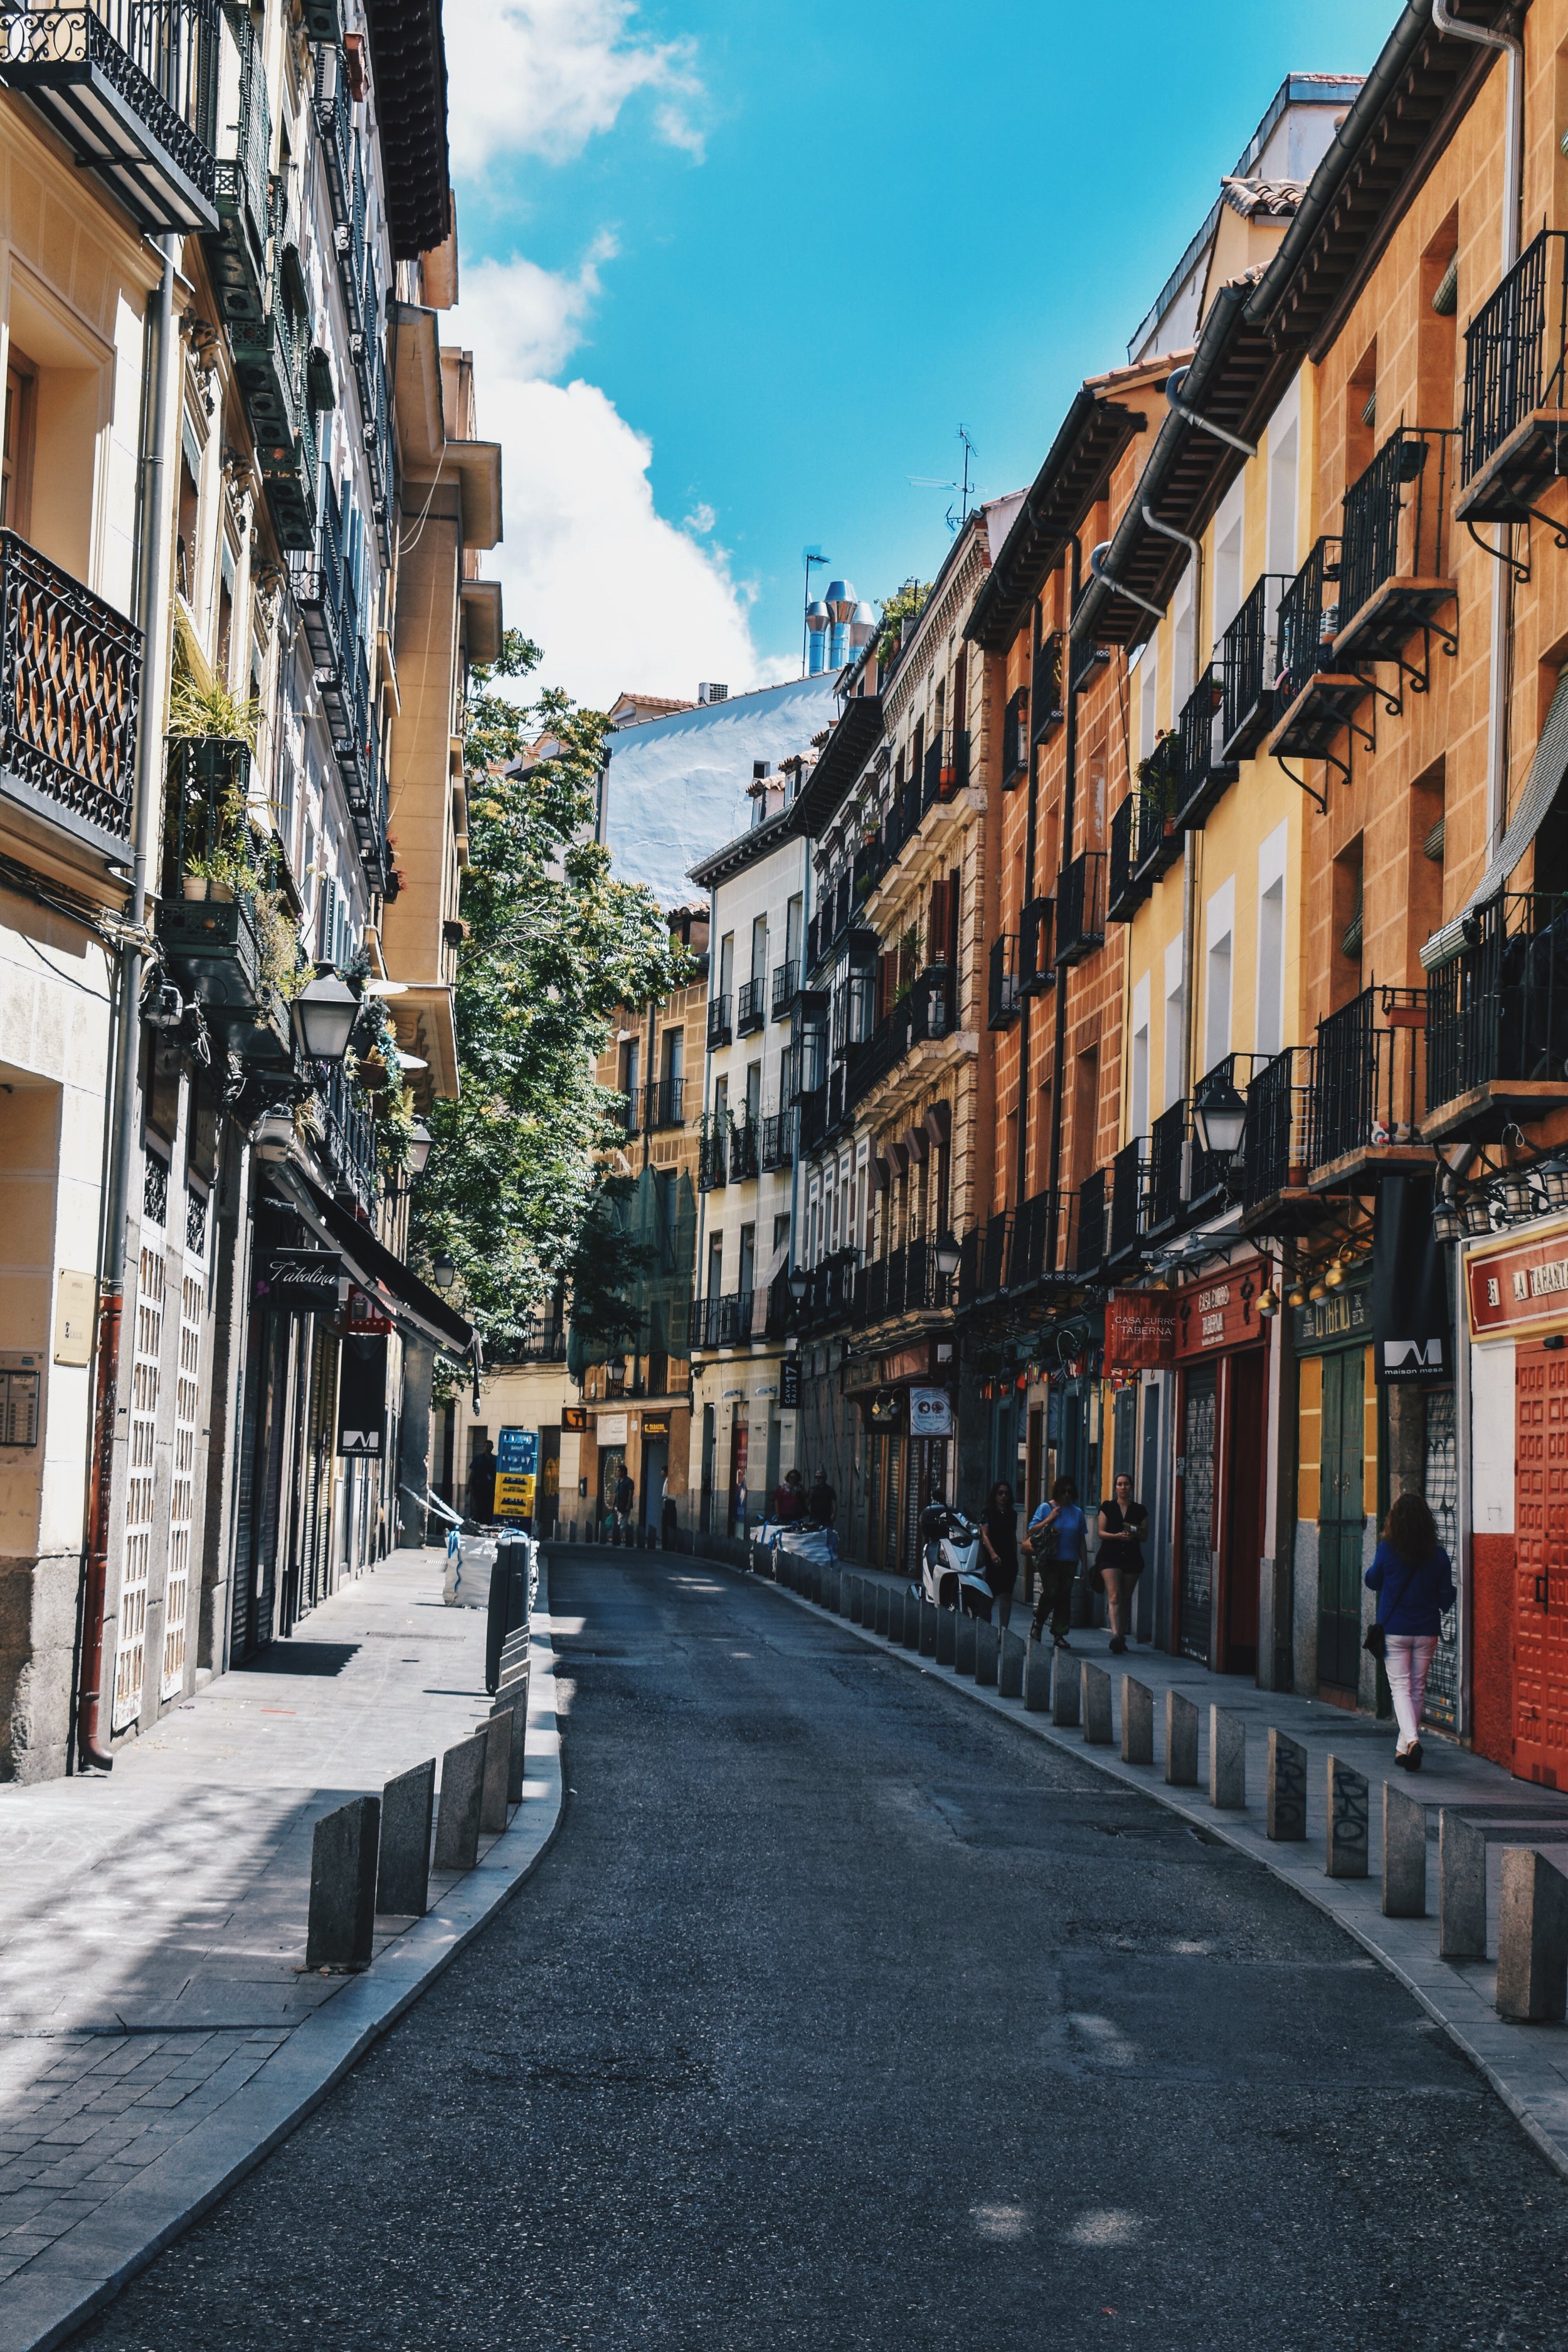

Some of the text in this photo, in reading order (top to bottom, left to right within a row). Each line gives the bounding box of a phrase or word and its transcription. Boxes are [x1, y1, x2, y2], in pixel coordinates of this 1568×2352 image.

[1199, 1285, 1230, 1313] CASA CURRO
[1121, 1326, 1172, 1335] TABERNA
[1202, 1312, 1223, 1336] TABERNA
[785, 1365, 797, 1382] 17
